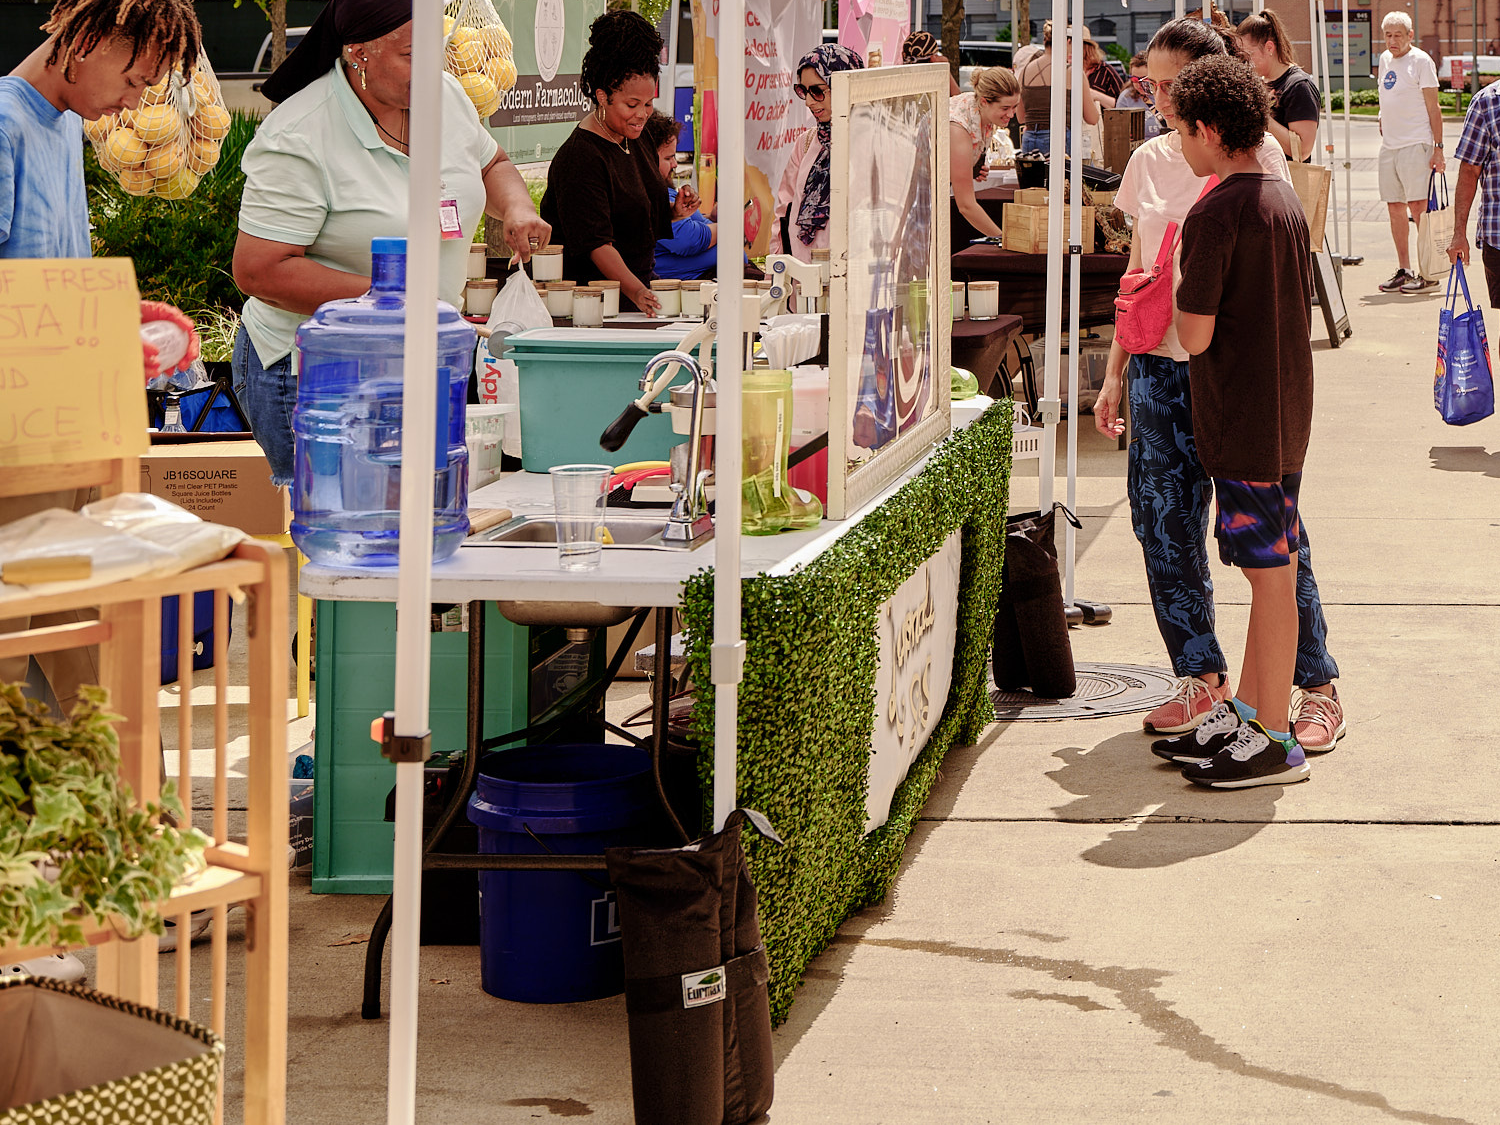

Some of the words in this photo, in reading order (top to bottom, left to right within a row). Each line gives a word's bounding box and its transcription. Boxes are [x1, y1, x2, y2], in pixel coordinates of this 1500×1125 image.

[746, 101, 765, 121] No
[41, 266, 130, 292] FRESH
[163, 469, 238, 481] JB16SQUARE
[180, 497, 196, 505] (Lids
[196, 497, 224, 505] Included)
